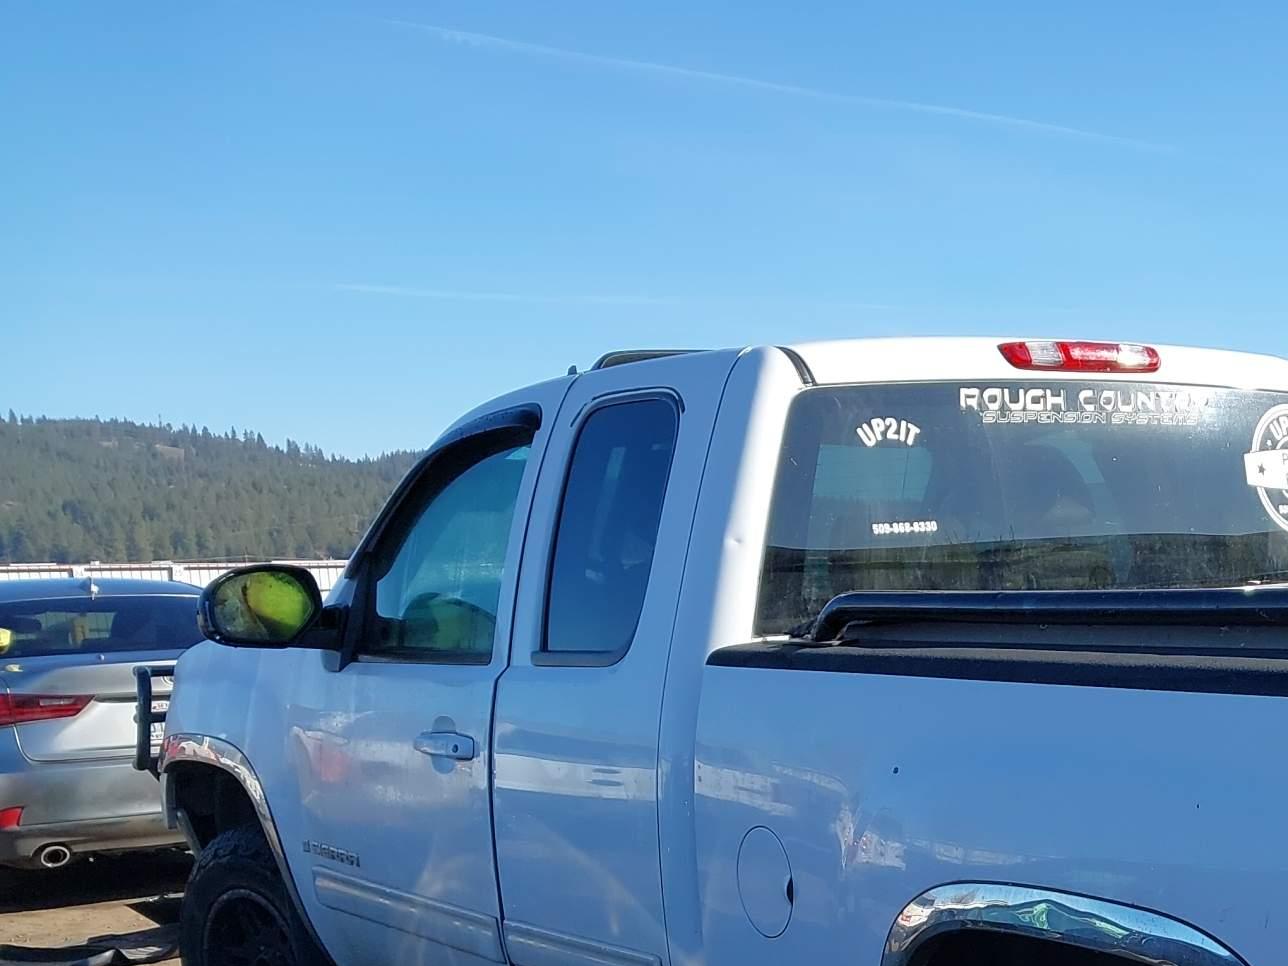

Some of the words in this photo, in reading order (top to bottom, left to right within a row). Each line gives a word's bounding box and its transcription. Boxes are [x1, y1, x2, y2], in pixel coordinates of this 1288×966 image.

[959, 387, 1067, 411] ROUGH
[981, 410, 1106, 424] SUSPENSION
[1110, 412, 1199, 426] SYSTEMS
[856, 417, 921, 448] UP2IT
